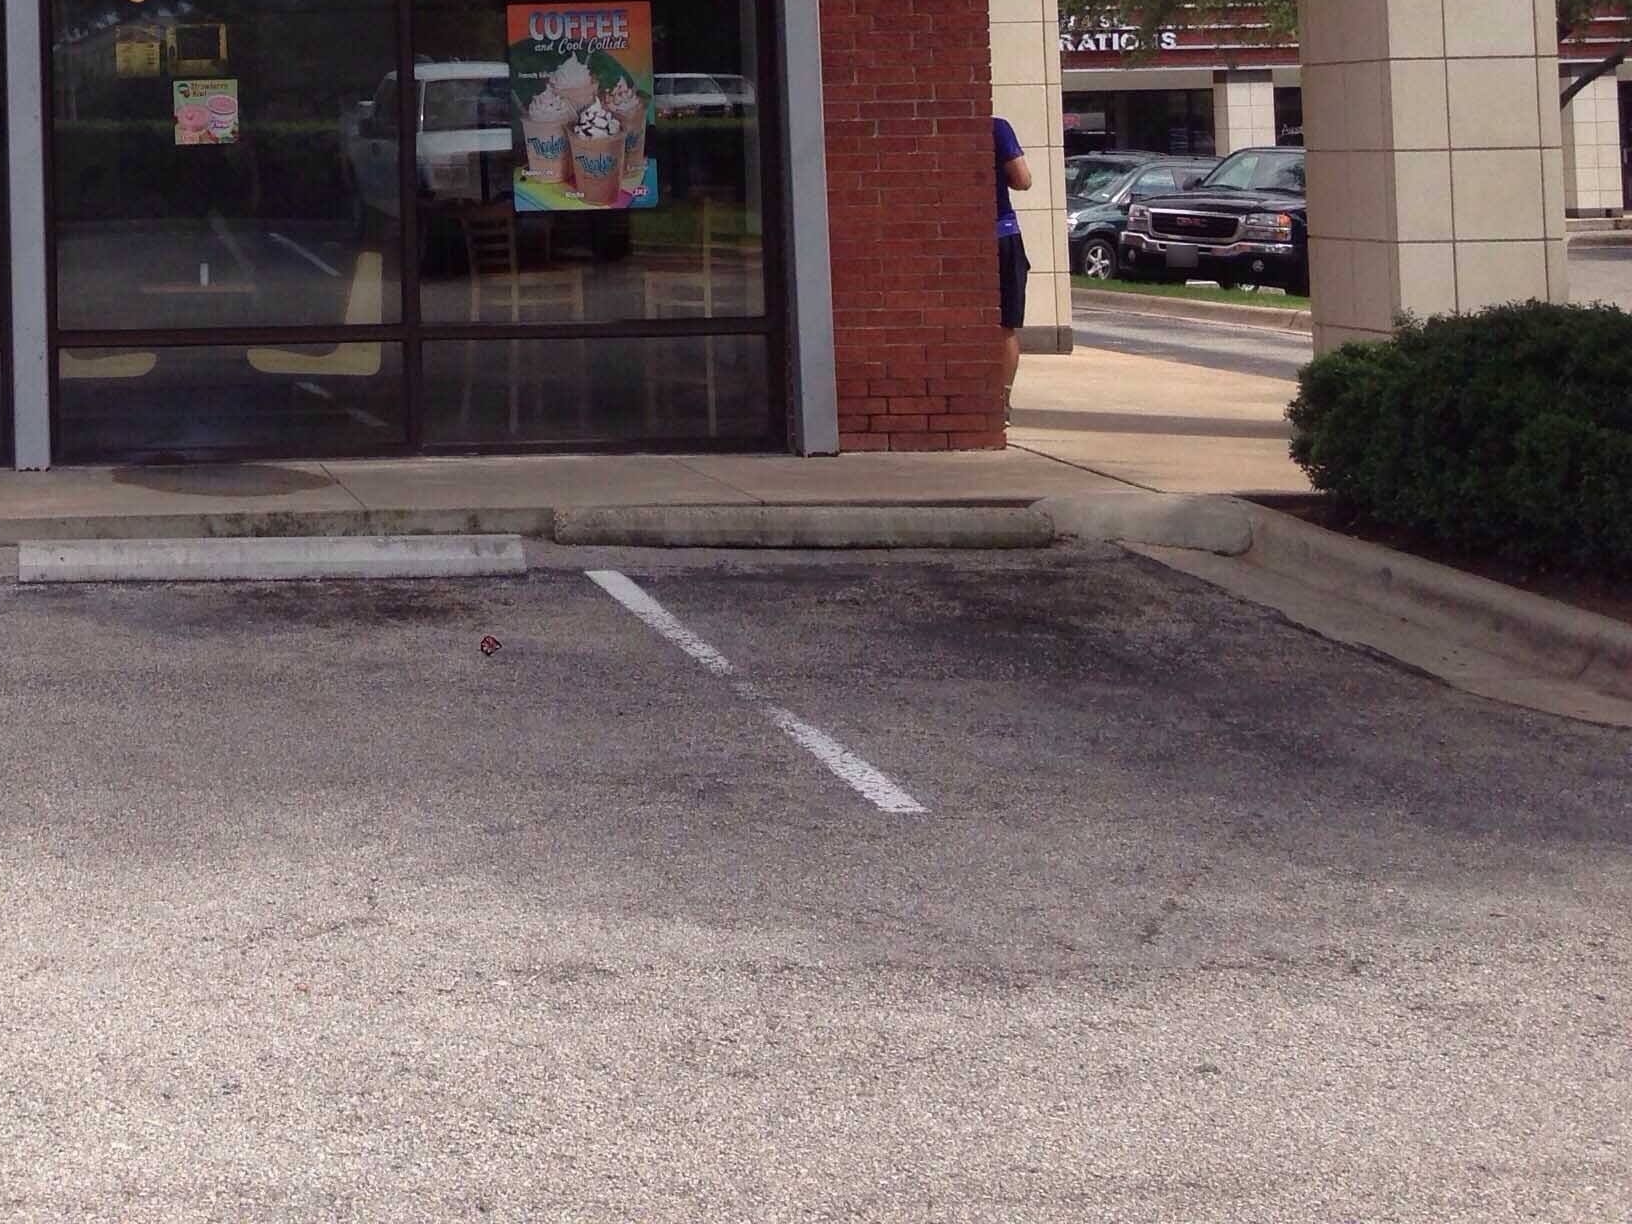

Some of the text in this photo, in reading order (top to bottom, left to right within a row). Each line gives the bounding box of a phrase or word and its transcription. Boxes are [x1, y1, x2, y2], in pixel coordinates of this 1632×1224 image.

[528, 9, 629, 40] COFFEE
[534, 42, 554, 52] and
[558, 37, 583, 55] Cool
[1061, 31, 1177, 51] RATIOS
